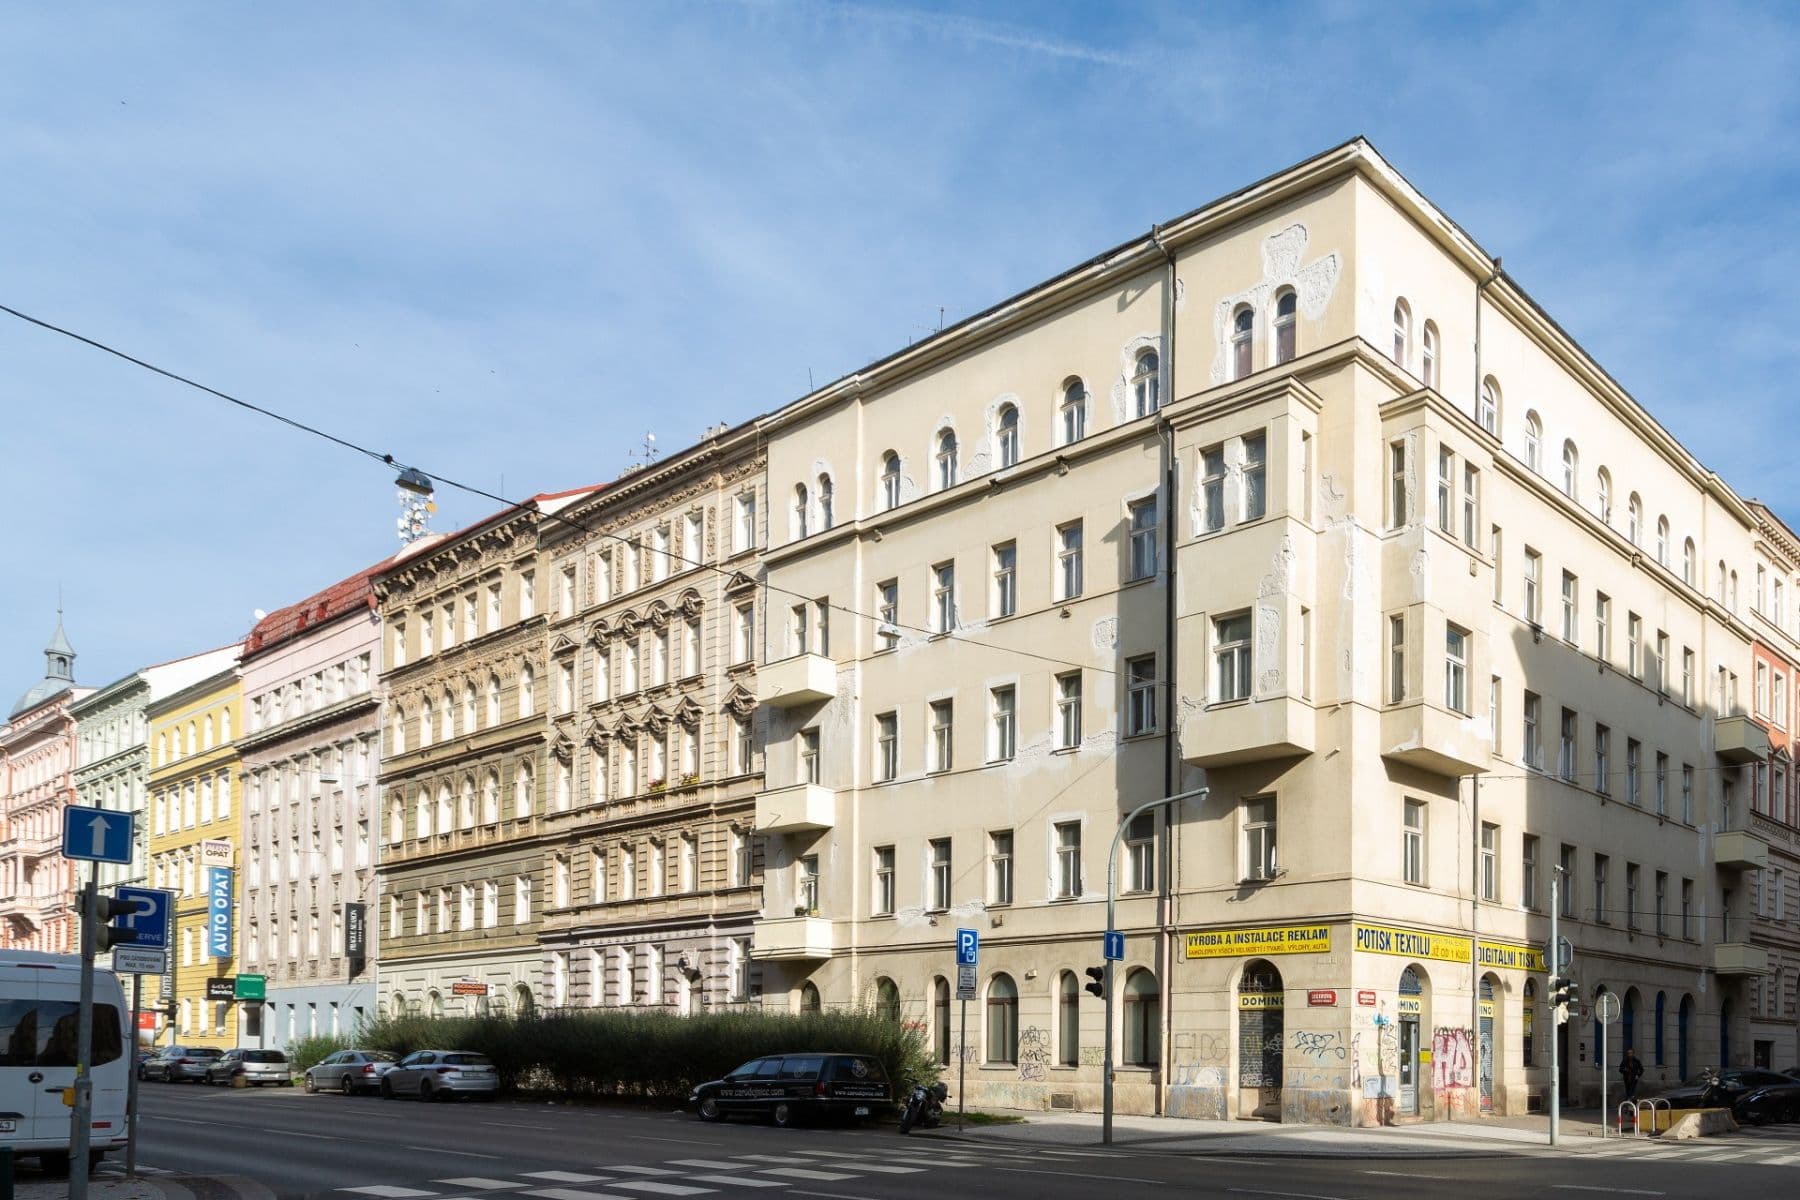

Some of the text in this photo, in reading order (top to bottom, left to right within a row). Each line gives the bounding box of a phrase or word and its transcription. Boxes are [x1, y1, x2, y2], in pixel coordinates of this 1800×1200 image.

[206, 850, 228, 858] OPAT
[127, 895, 157, 928] P
[214, 872, 229, 952] AUTO OPAT
[962, 933, 974, 954] P
[1188, 928, 1328, 946] VÝROBA A INSTALACE REKLAM
[1357, 928, 1430, 956] POTISK TEXTILU
[1519, 951, 1536, 968] TISK
